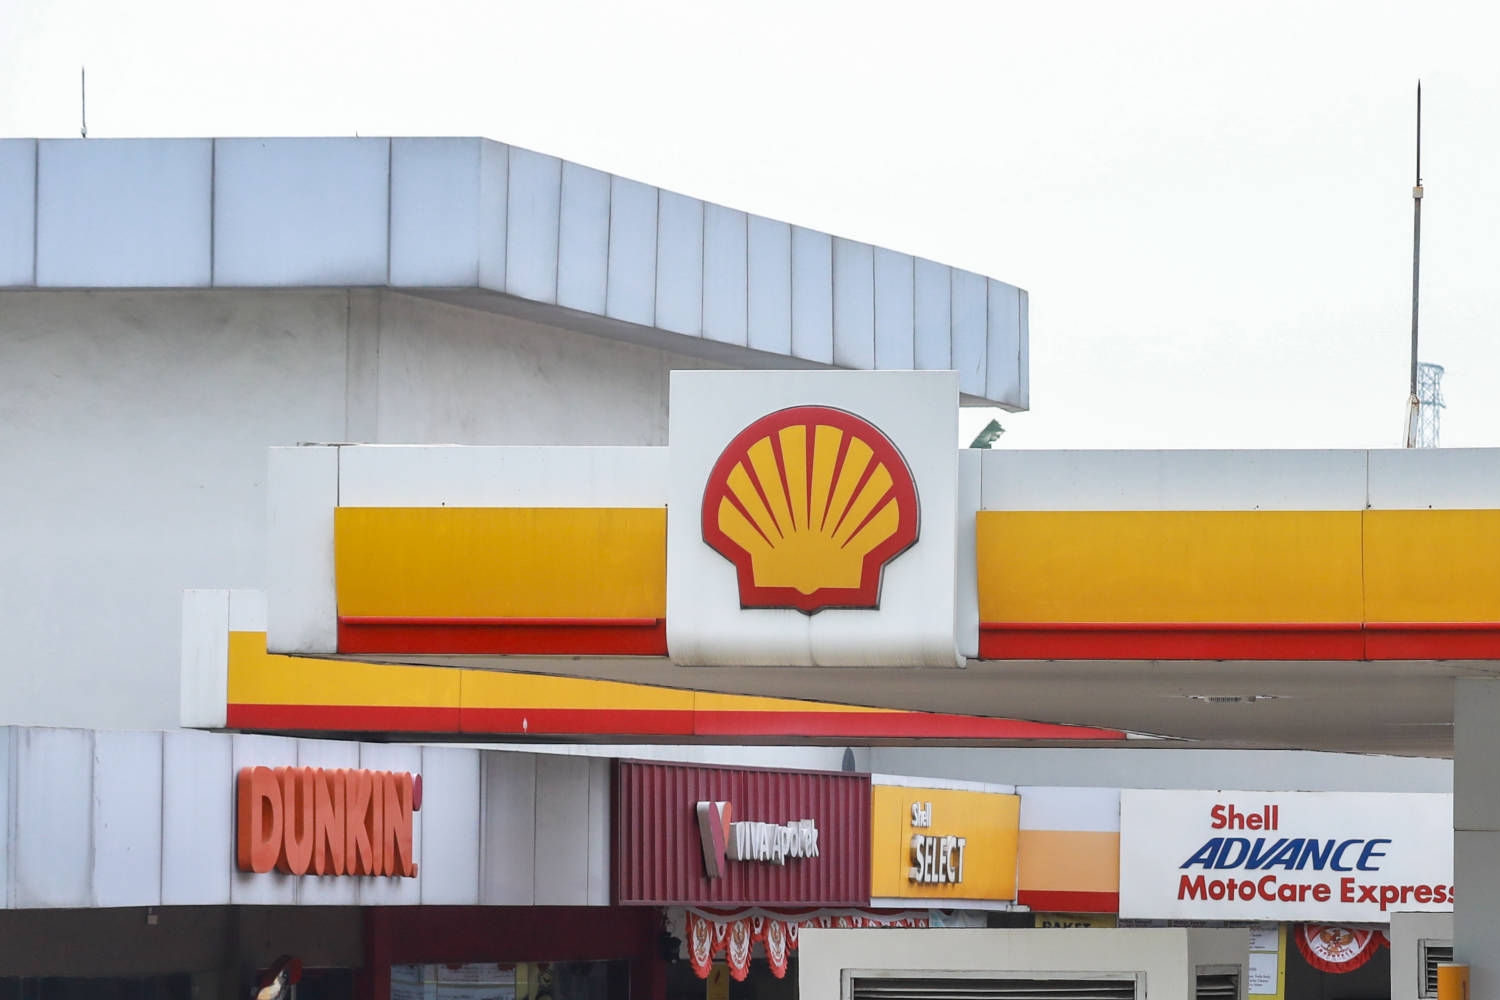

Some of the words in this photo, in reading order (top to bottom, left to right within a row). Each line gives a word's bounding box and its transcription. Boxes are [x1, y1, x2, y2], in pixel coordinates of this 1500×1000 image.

[911, 801, 932, 828] Shell
[1210, 804, 1279, 831] Shell
[728, 821, 771, 860] VIVA
[1179, 837, 1392, 872] ADVANCE
[913, 834, 967, 884] SELECT
[1177, 875, 1332, 902] MotoCare
